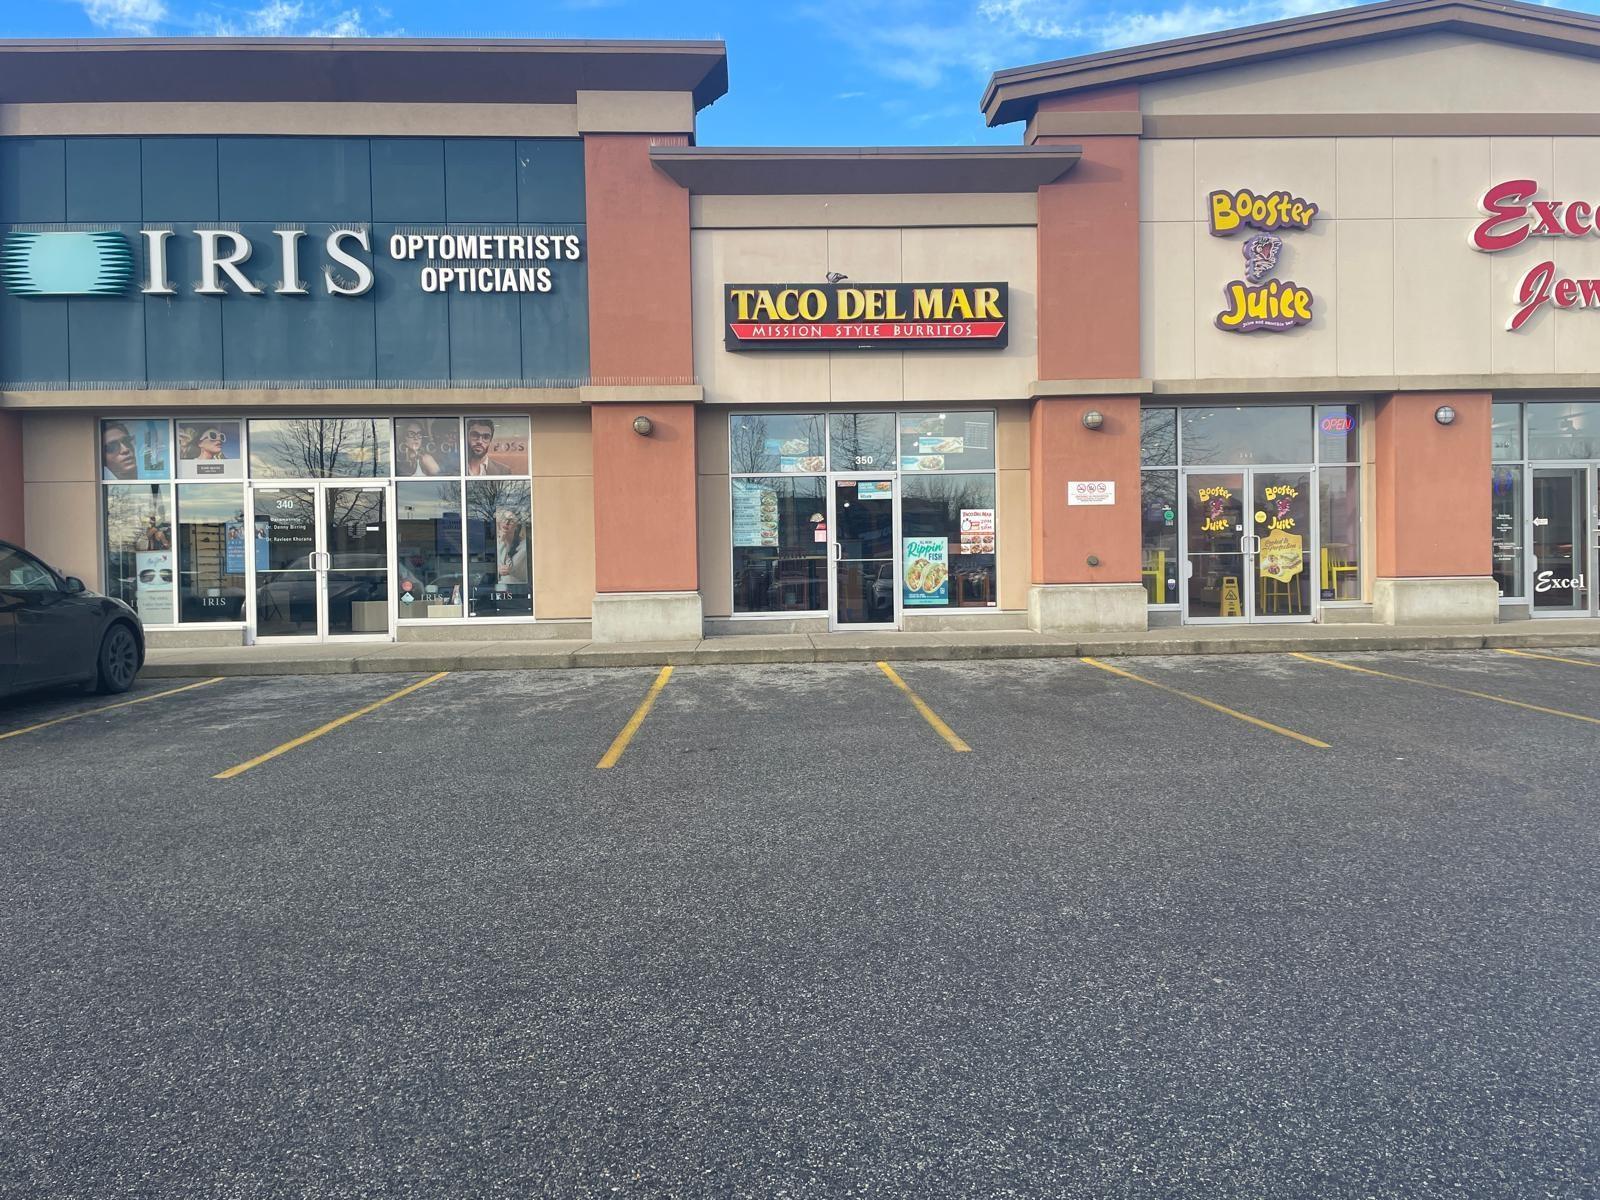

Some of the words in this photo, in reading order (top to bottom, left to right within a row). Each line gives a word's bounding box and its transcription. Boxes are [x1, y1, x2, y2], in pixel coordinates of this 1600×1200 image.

[1212, 191, 1315, 231] Booster
[390, 234, 580, 260] OPTOMETRISTS
[140, 229, 374, 296] IRIS
[421, 267, 552, 293] OPTICIANS
[731, 289, 828, 321] TACO
[838, 288, 907, 321] DEL
[913, 287, 1004, 320] MAR
[1221, 281, 1312, 325] Juice
[752, 325, 823, 338] MISSION
[835, 324, 881, 337] STYLE
[893, 323, 973, 337] BURRITOS
[1322, 417, 1352, 431] OPEN
[855, 455, 873, 465] 350
[1199, 486, 1232, 502] Booster
[1265, 485, 1299, 501] Booster
[276, 500, 294, 509] 340
[1201, 517, 1229, 531] Juice
[1267, 516, 1296, 530] Juice
[928, 552, 943, 561] FISH
[1535, 570, 1585, 592] Excel
[202, 598, 227, 607] IRIS
[491, 592, 513, 600] IRIS
